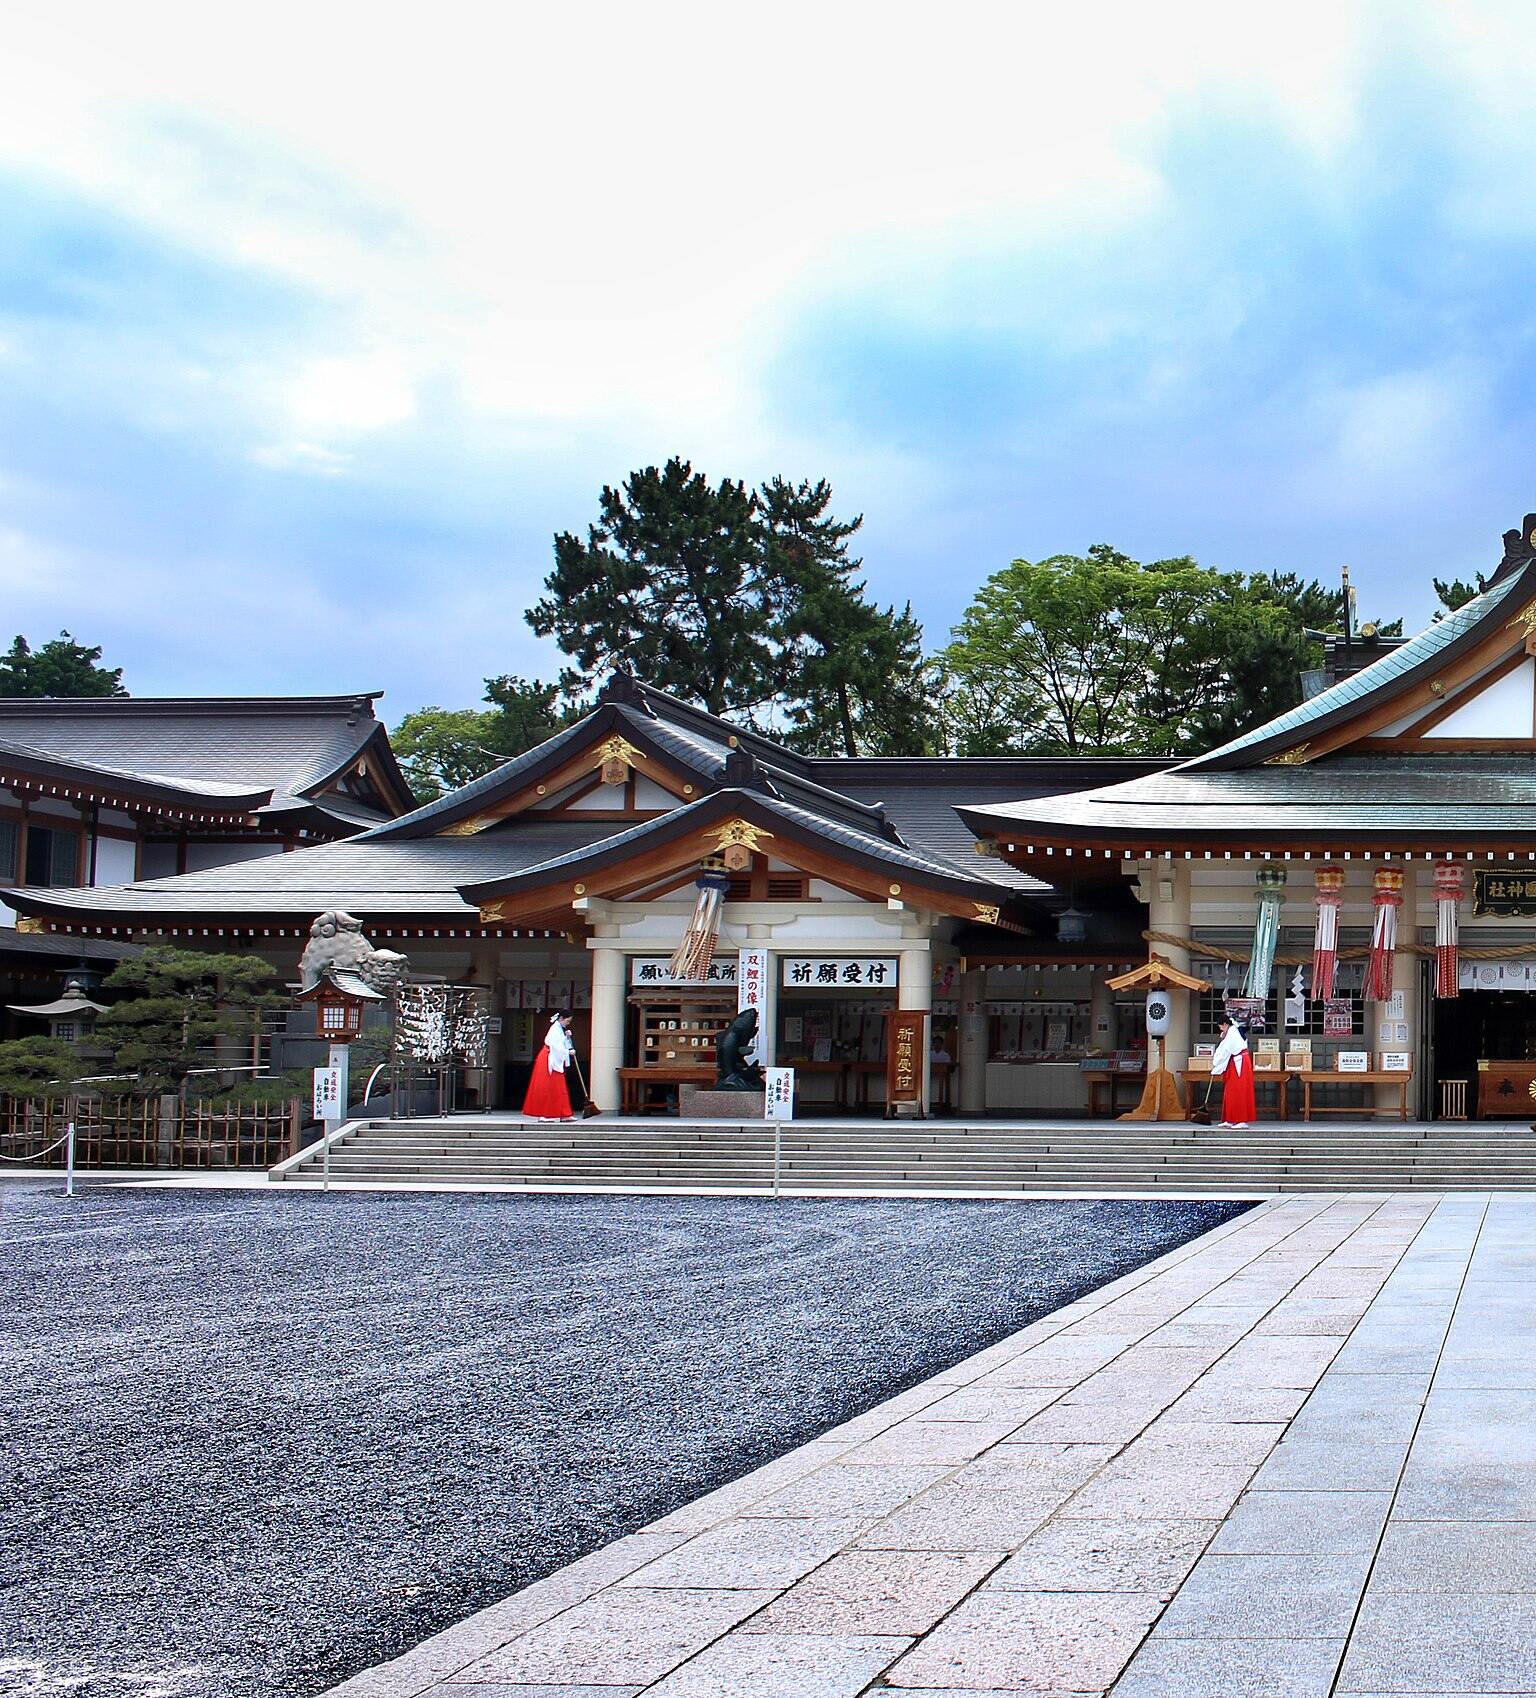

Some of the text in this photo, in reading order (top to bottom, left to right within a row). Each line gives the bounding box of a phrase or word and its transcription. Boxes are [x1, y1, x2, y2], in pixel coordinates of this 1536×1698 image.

[747, 955, 759, 1005] 双鯉の像
[792, 962, 888, 984] 祈願受付
[897, 1027, 914, 1088] 祈願受付
[775, 1077, 783, 1102] 自動車
